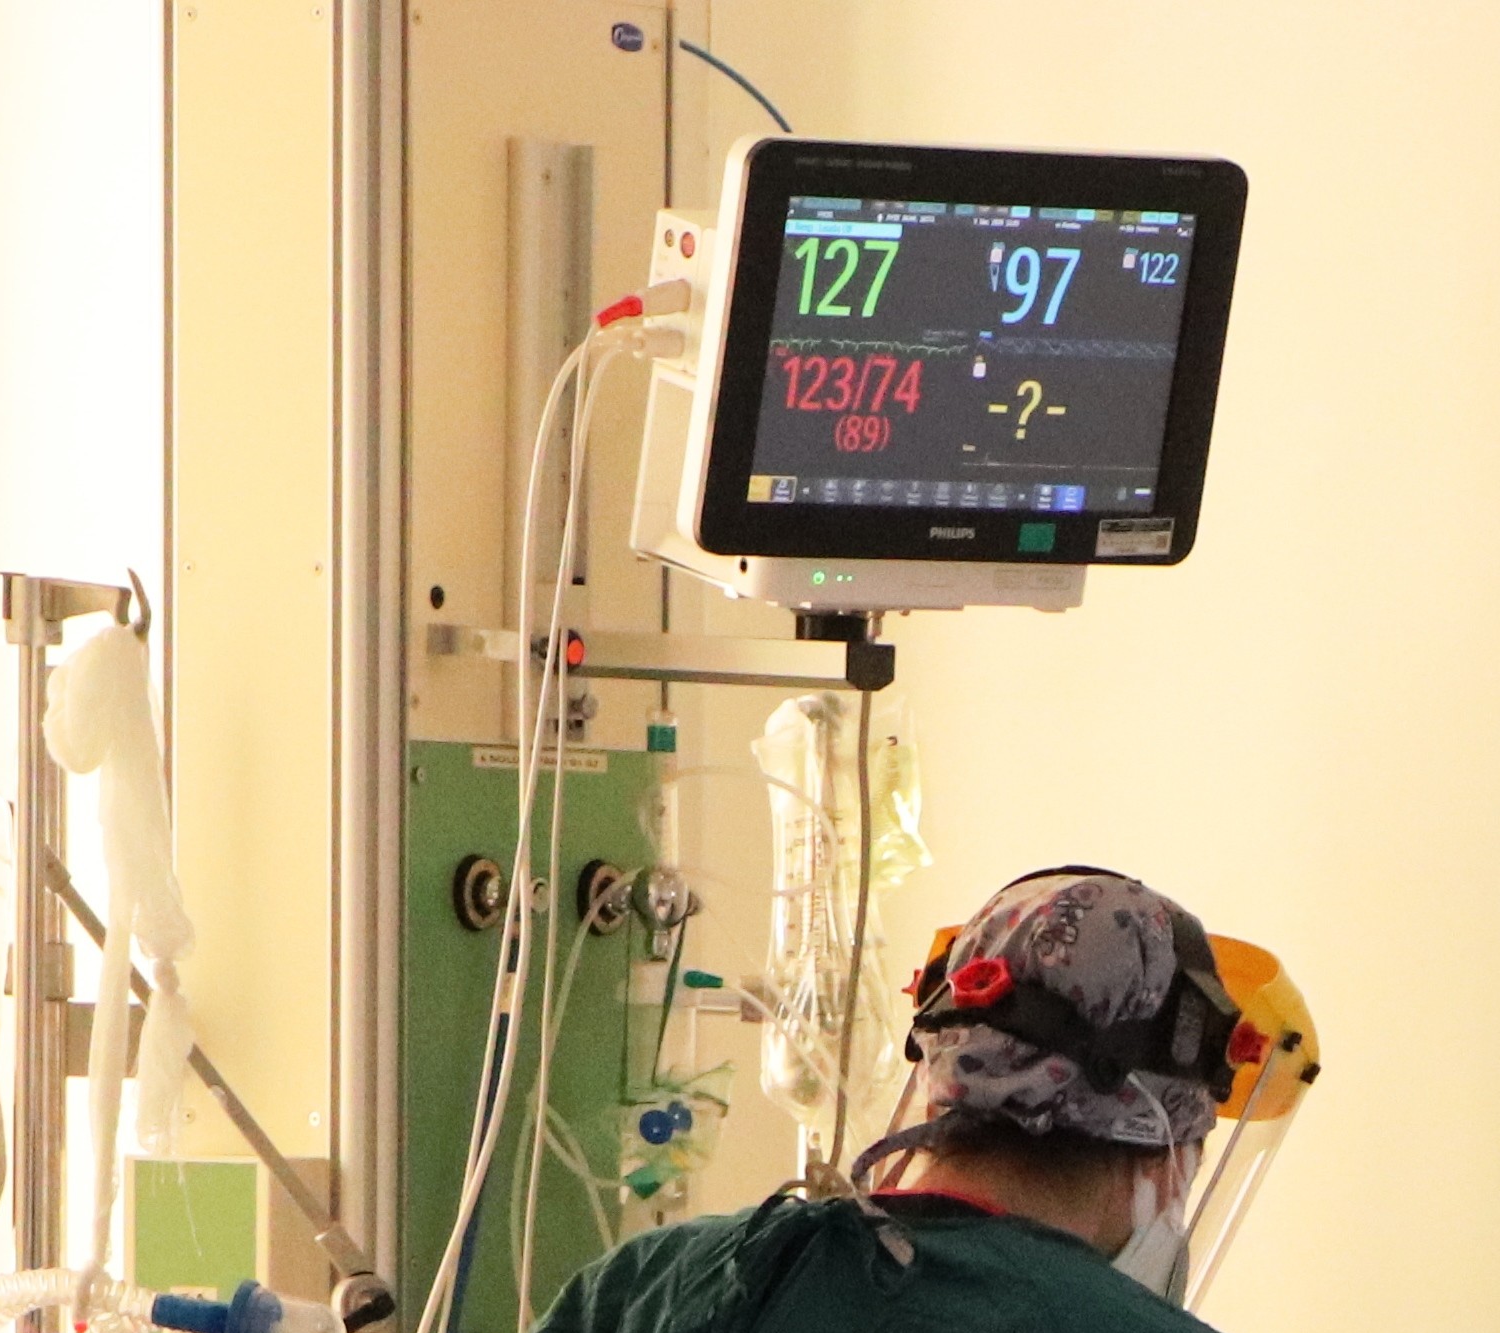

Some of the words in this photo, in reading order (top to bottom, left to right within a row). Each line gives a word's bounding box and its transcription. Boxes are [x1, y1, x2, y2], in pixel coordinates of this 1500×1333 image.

[794, 237, 900, 318] 127
[1001, 246, 1082, 325] 97
[1139, 251, 1180, 284] 122
[781, 353, 924, 414] 123/74
[834, 414, 892, 453] (89)
[929, 526, 976, 540] PHILIPS
